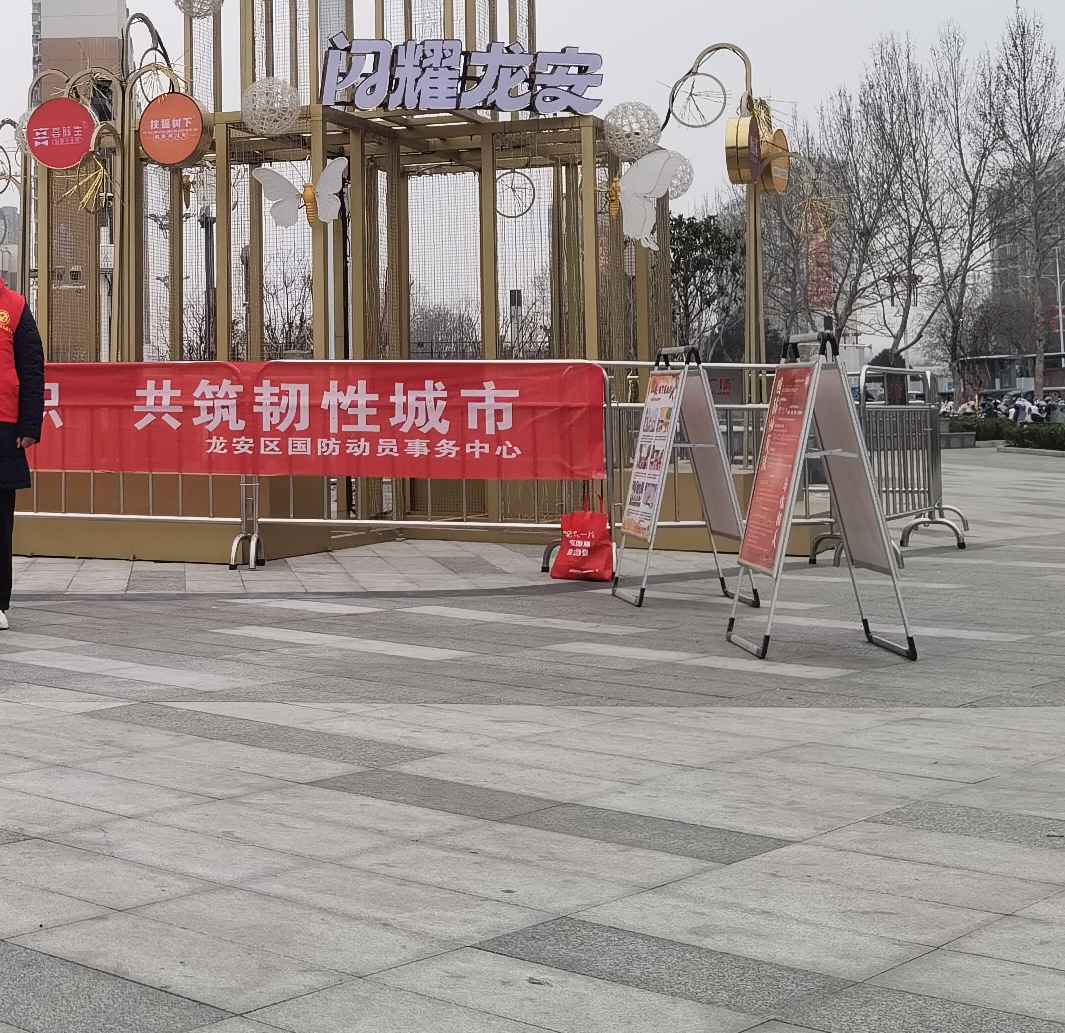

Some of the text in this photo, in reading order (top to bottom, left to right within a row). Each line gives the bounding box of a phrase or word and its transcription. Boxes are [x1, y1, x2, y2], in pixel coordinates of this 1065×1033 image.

[321, 31, 604, 114] 闪耀龙安
[134, 378, 520, 435] 共筑韧性城市
[205, 434, 523, 460] 龙安区国防动员事务中心
